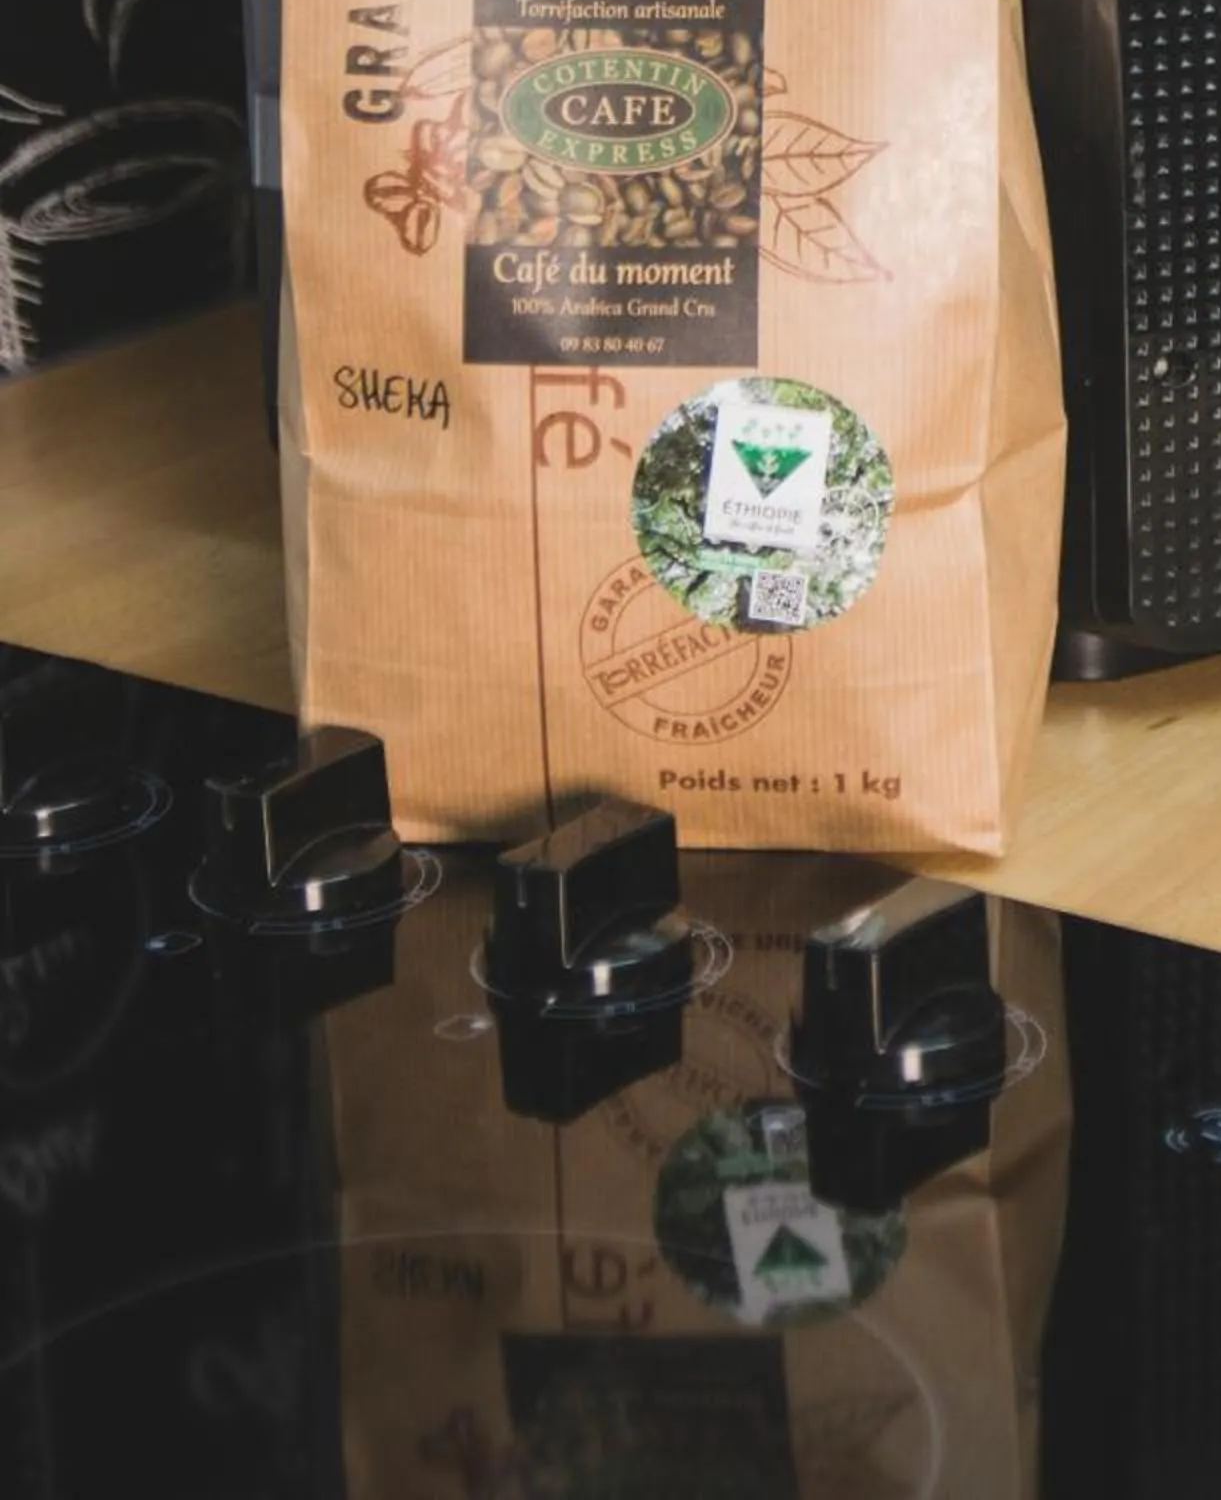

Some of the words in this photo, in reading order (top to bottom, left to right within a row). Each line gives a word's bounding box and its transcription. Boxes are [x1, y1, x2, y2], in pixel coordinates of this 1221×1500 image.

[531, 59, 708, 96] COTENTIN
[560, 95, 677, 126] CAFE
[540, 129, 699, 165] EXPRESS
[492, 252, 560, 293] Café
[569, 252, 608, 284] du
[616, 256, 737, 285] moment
[511, 299, 556, 316] 100%
[559, 297, 623, 317] Arabica
[626, 299, 680, 317] Grand
[683, 299, 716, 317] Cru
[333, 365, 451, 430] SHEKA
[532, 366, 634, 470] fé
[590, 565, 649, 633] GARA
[658, 768, 742, 792] Poids
[752, 774, 801, 793] net
[832, 772, 847, 794] 1
[860, 770, 903, 798] kg
